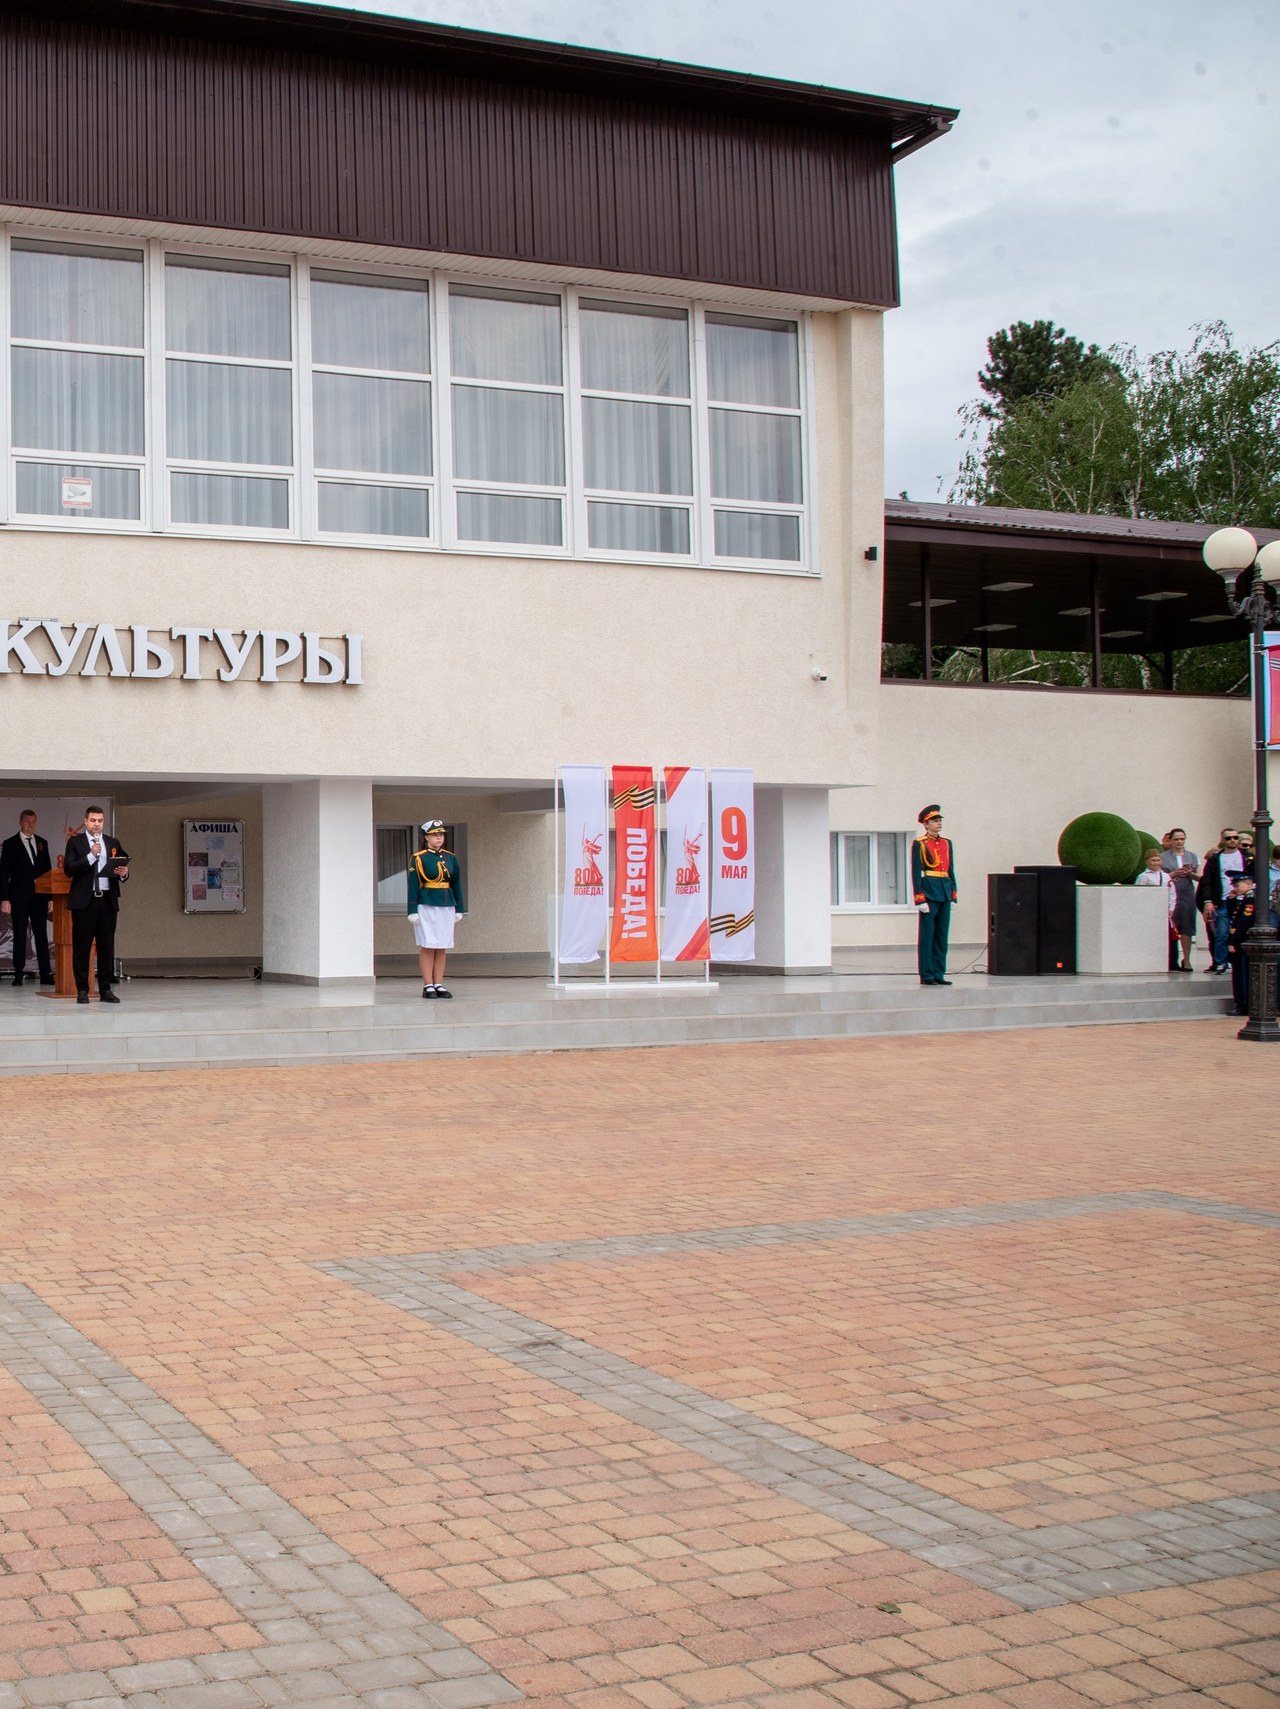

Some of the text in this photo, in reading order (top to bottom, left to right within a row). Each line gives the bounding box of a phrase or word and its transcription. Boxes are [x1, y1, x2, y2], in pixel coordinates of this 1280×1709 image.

[190, 823, 238, 833] АФИША
[721, 807, 747, 861] 9
[575, 867, 591, 885] 80
[721, 865, 748, 879] МАЯ
[621, 827, 648, 939] ПОБЕДА!
